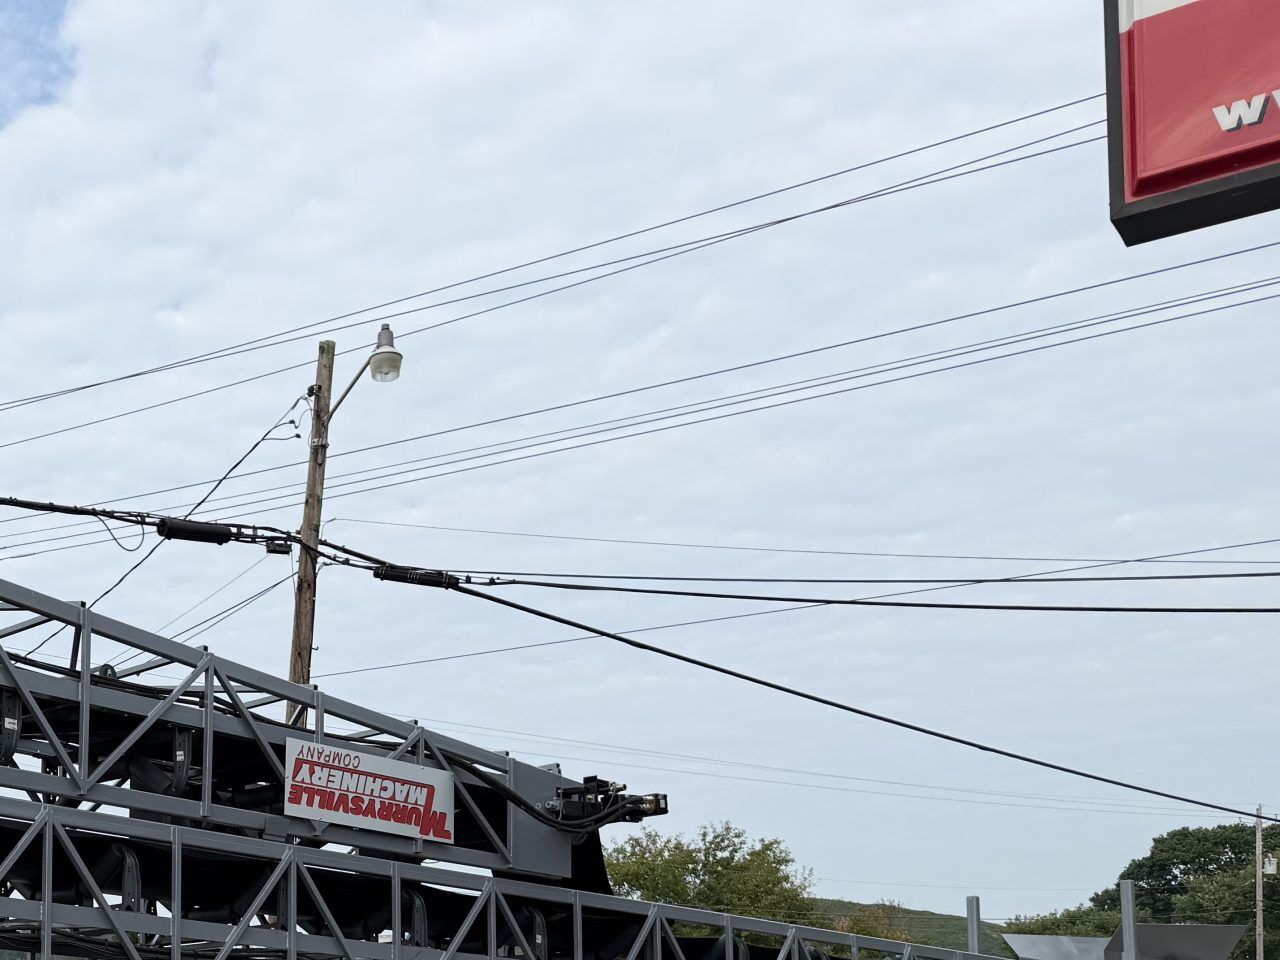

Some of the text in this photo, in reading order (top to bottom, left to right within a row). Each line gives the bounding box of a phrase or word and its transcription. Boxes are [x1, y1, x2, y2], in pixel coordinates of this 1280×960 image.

[297, 744, 361, 769] COMPANY
[294, 762, 428, 805] MACHINERY
[288, 783, 452, 840] MURRYSVILLE
